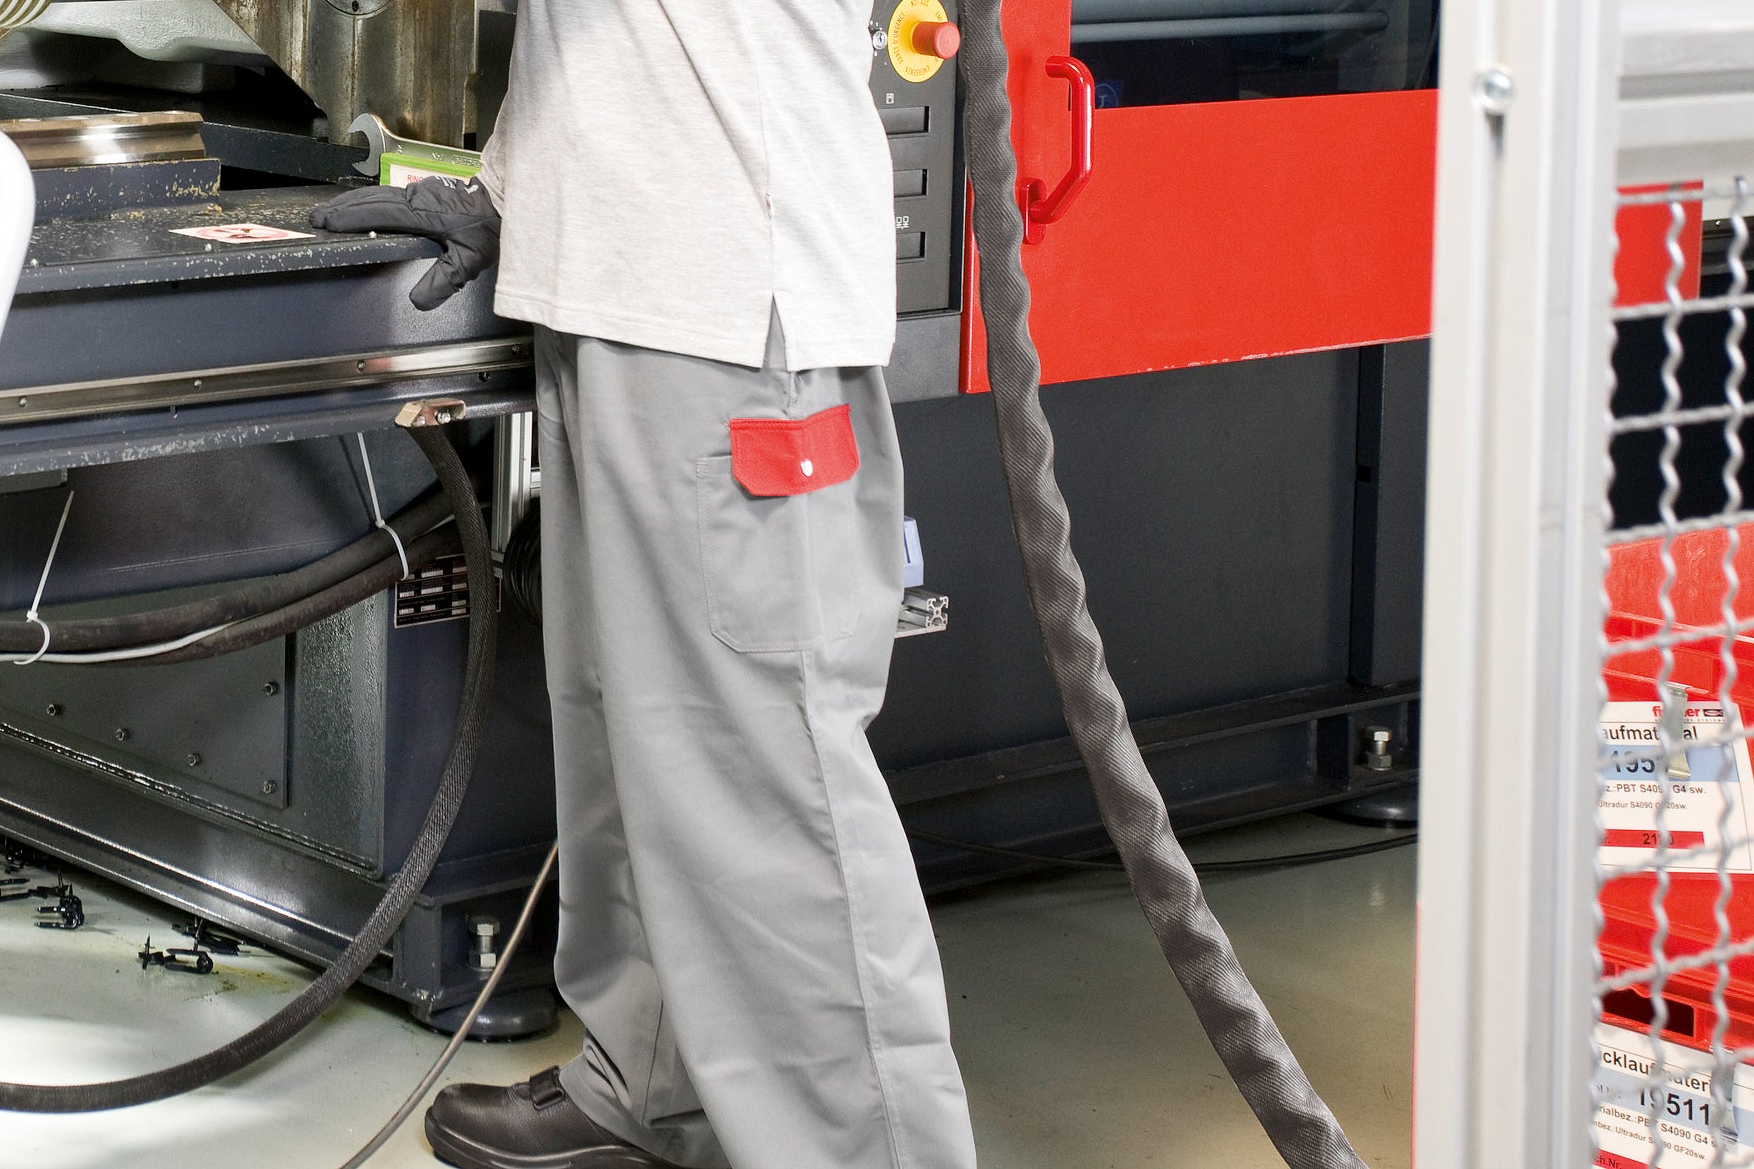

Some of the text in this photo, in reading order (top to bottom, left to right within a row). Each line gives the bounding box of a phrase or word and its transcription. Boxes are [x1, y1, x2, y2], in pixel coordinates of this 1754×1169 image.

[1652, 706, 1700, 718] fier
[1672, 784, 1687, 794] G4
[1661, 1122, 1691, 1140] S4090
[1694, 1133, 1708, 1145] G4
